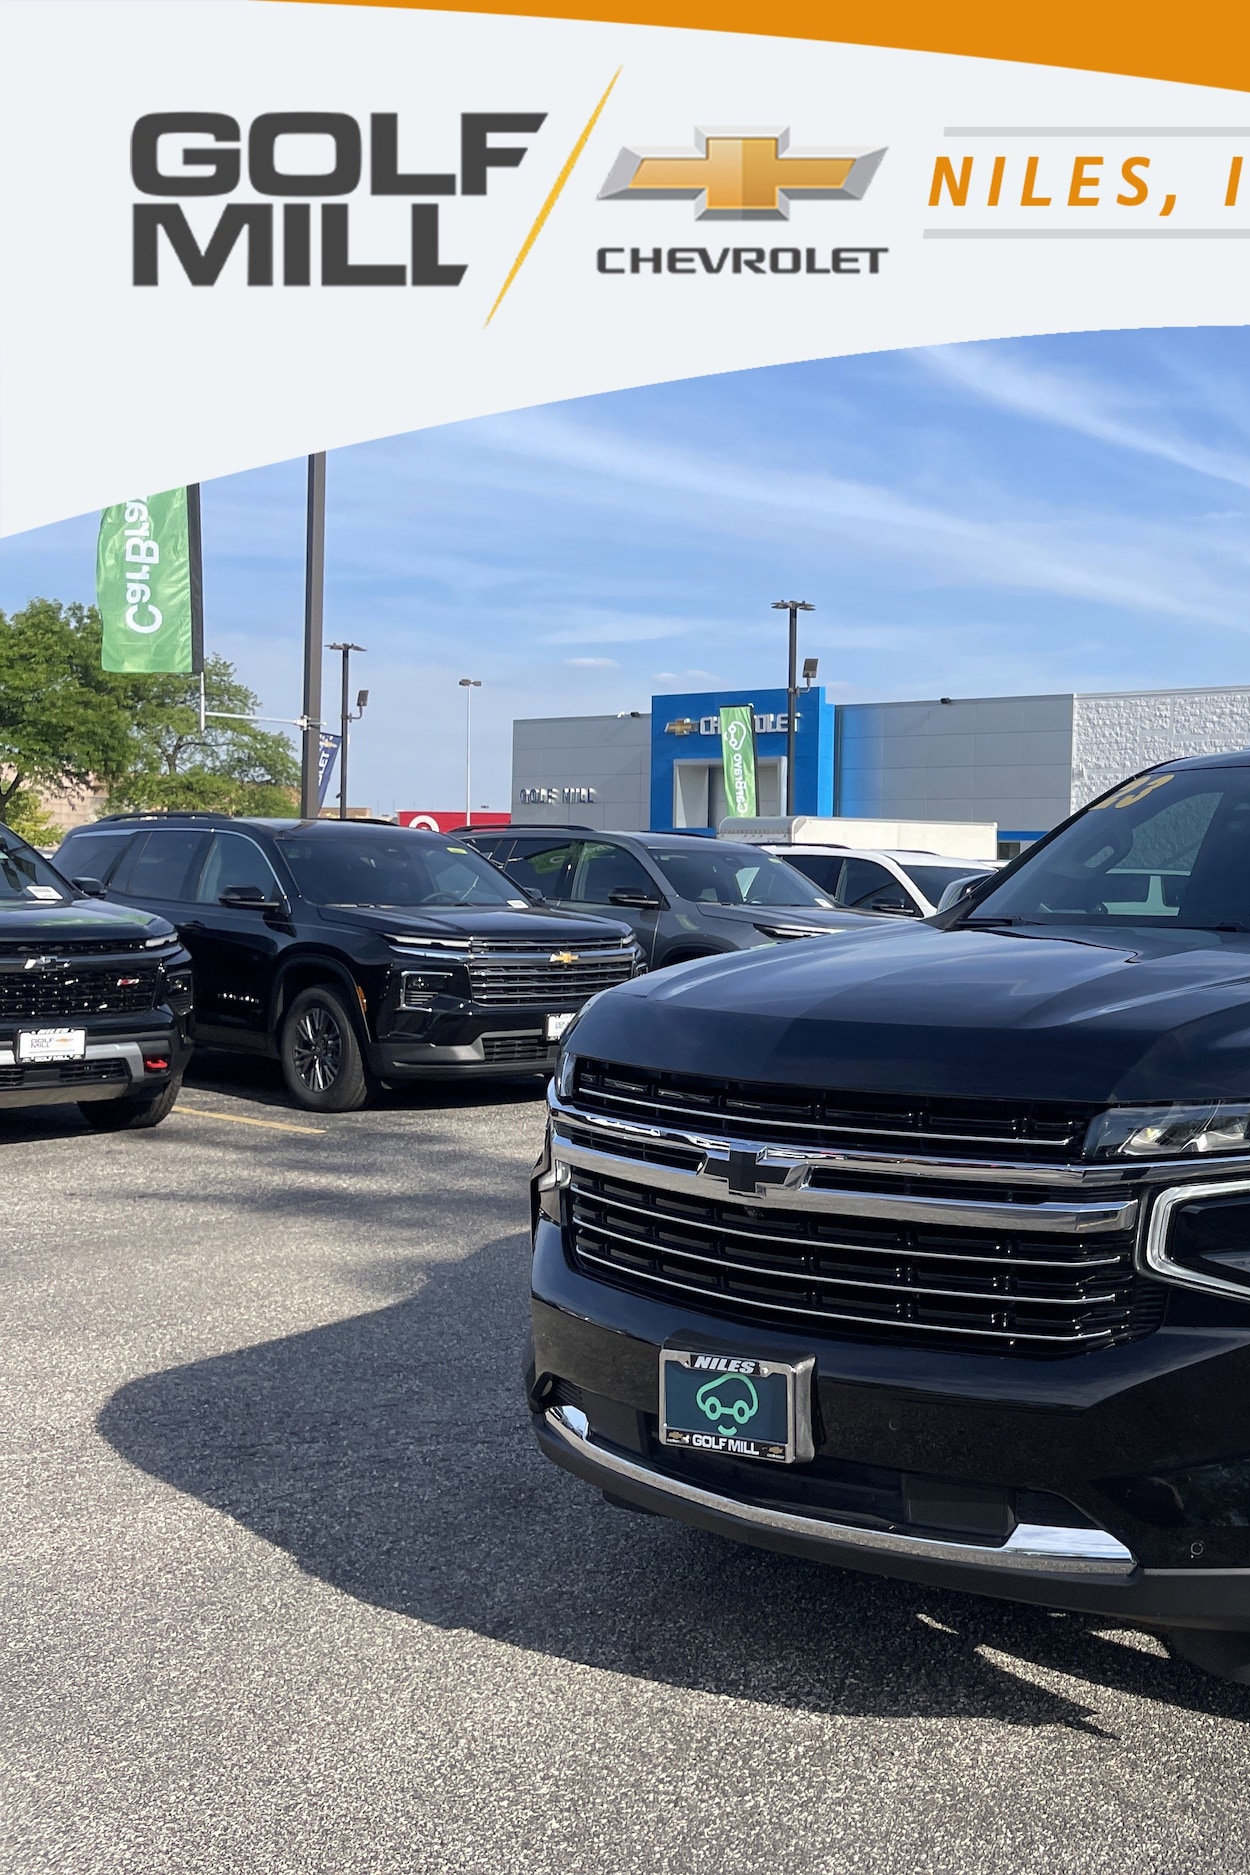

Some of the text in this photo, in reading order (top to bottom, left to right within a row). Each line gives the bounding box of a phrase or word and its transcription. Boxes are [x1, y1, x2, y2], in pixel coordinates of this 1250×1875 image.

[700, 712, 800, 735] CHOLET
[694, 1355, 754, 1374] NILES
[692, 1434, 759, 1456] GOLF MILL
